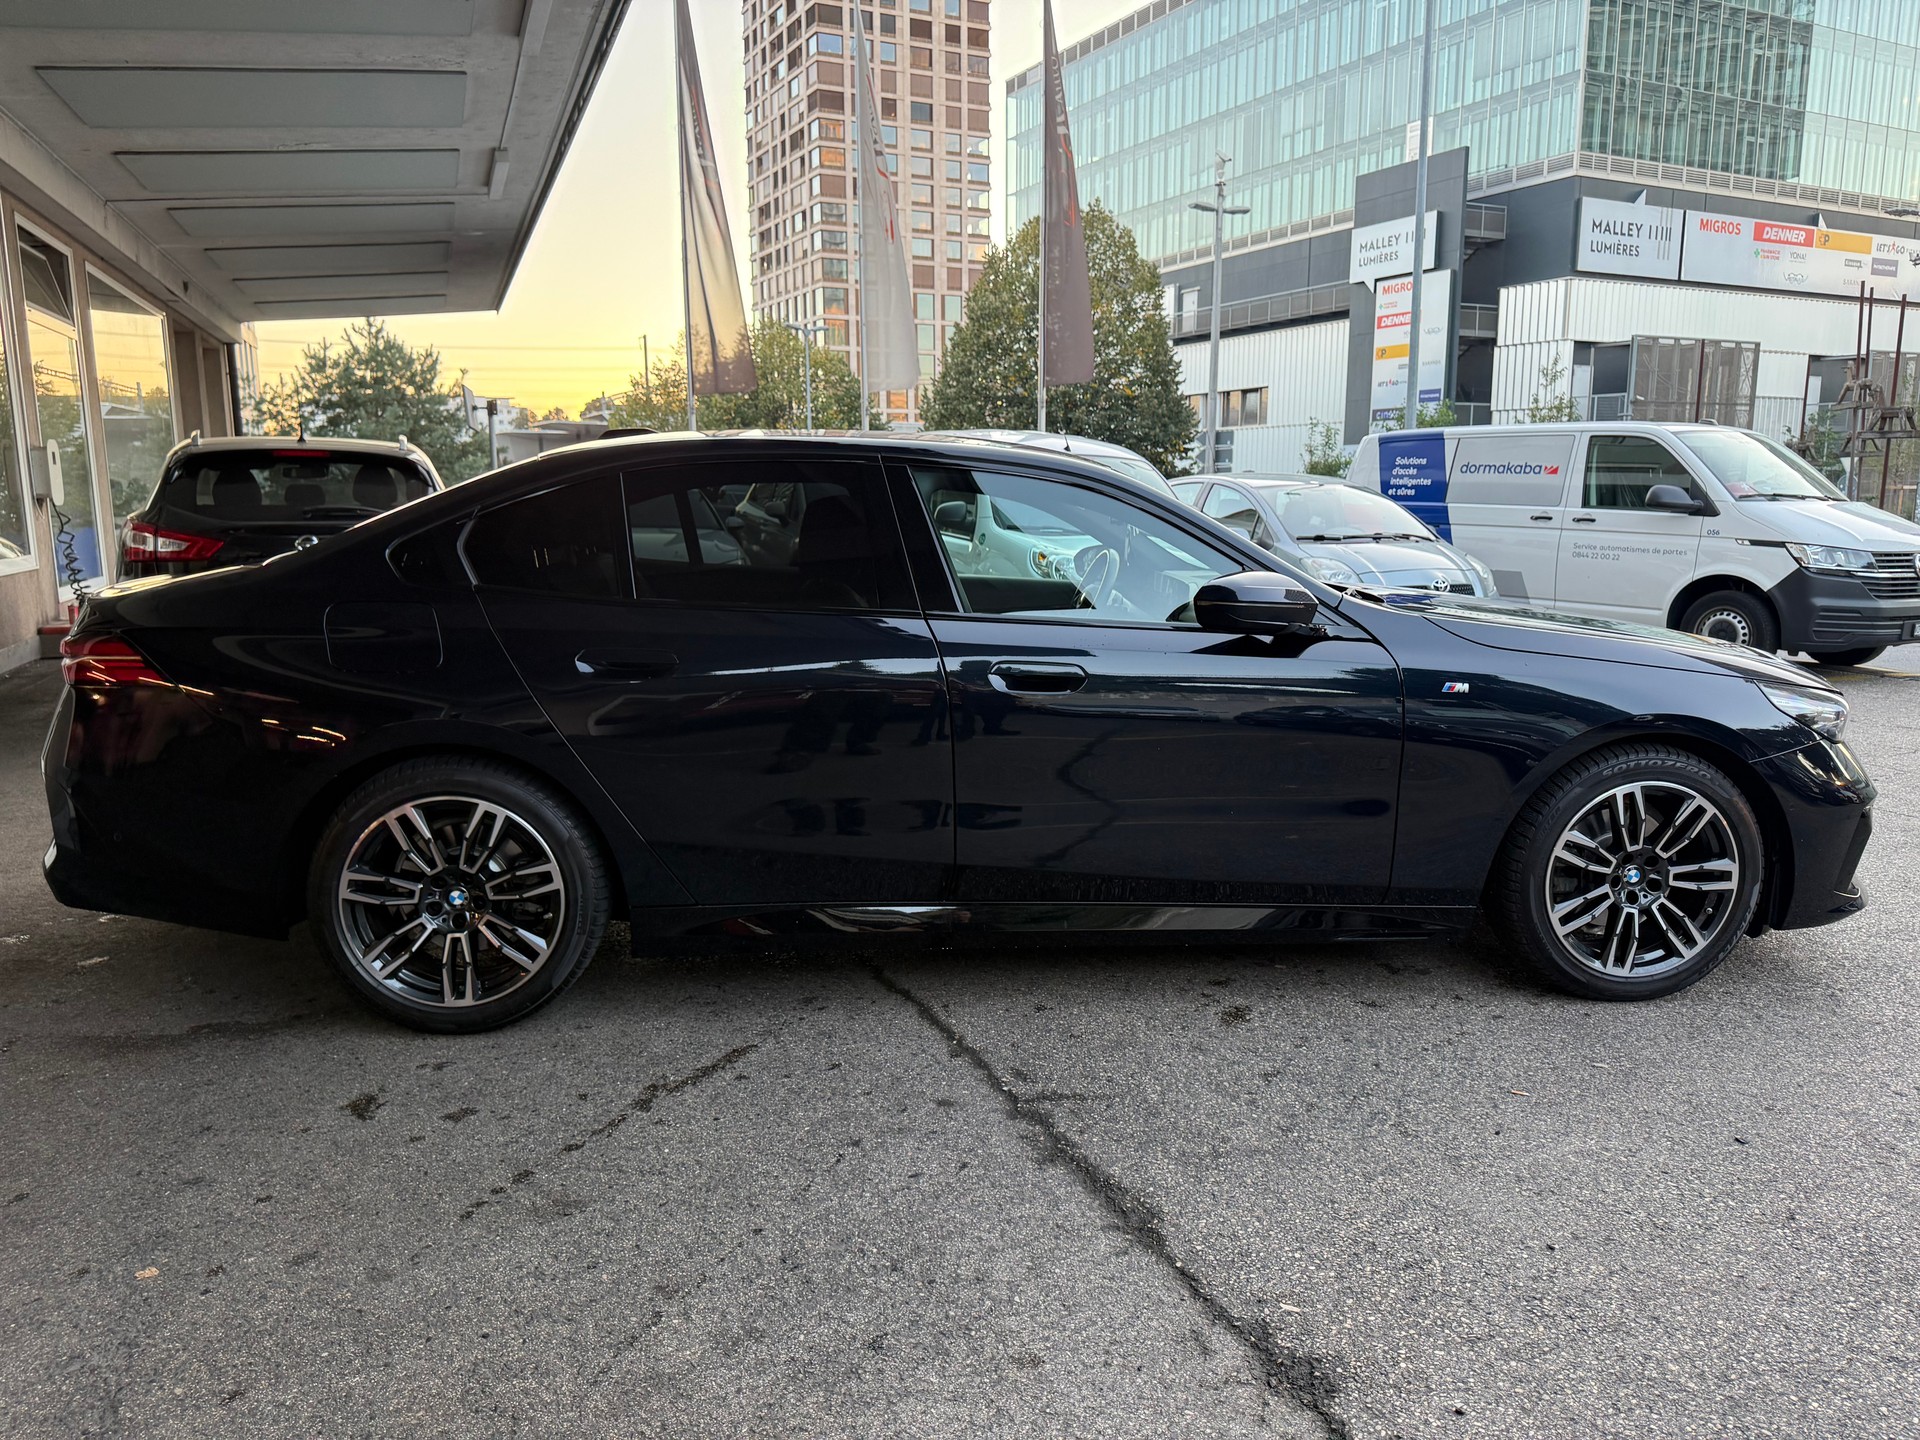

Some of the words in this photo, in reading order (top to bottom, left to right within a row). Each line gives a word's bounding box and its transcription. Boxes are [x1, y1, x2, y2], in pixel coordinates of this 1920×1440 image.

[1591, 218, 1643, 241] MALLEY
[1699, 218, 1741, 236] MIGROS
[1763, 226, 1806, 243] DENNER
[1359, 233, 1401, 253] MALLEY
[1590, 239, 1640, 257] LUMIÈRES
[1358, 250, 1399, 268] LUMIÈRES
[1382, 281, 1413, 296] MIGRO
[1380, 315, 1411, 327] DENNE
[1395, 456, 1427, 465] Solutions
[1392, 466, 1417, 475] d'accès
[1460, 462, 1543, 475] dormakaba
[1390, 477, 1432, 487] intelligentes
[1388, 488, 1396, 496] et
[1396, 487, 1415, 496] sûres
[1572, 551, 1590, 559] 0844
[1590, 552, 1599, 560] 22
[1573, 542, 1598, 550] Service
[1599, 543, 1651, 554] automatismes
[1652, 547, 1661, 555] de
[1663, 547, 1688, 556] portes
[1602, 759, 1711, 779] SOTTOZERO
